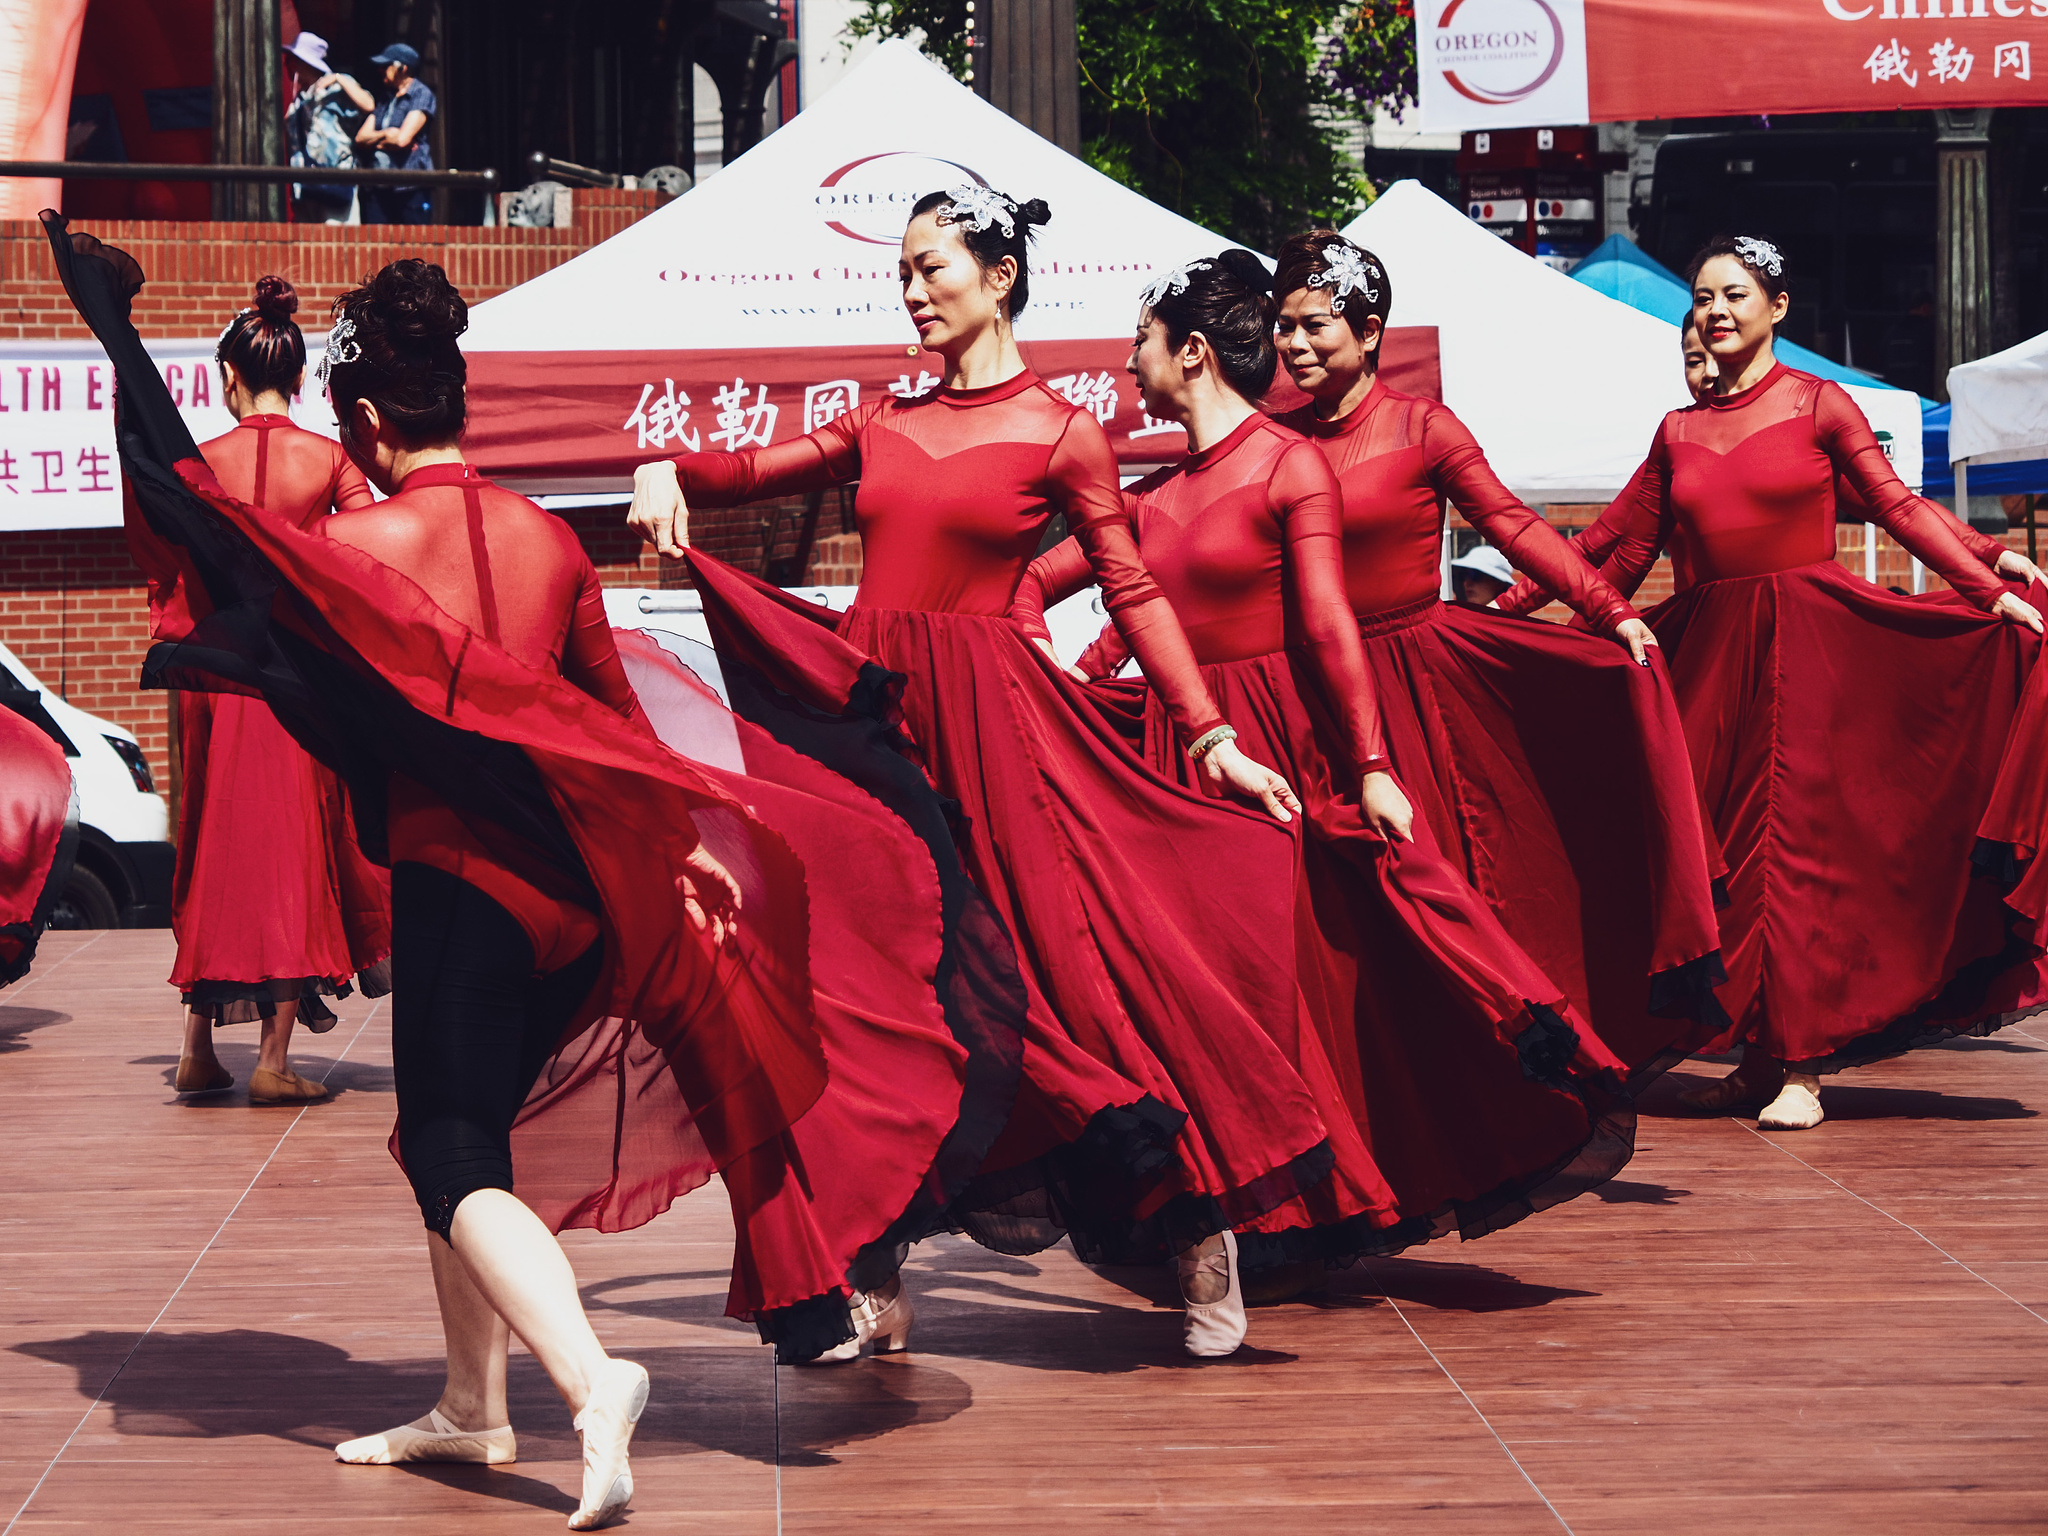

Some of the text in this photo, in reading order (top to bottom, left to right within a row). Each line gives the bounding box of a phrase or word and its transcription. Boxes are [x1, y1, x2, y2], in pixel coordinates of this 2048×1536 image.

[1435, 30, 1538, 52] OREGON
[1863, 37, 2031, 88] 俄勒冈
[815, 192, 919, 205] OREG
[659, 260, 1152, 285] Oregon Chin alition
